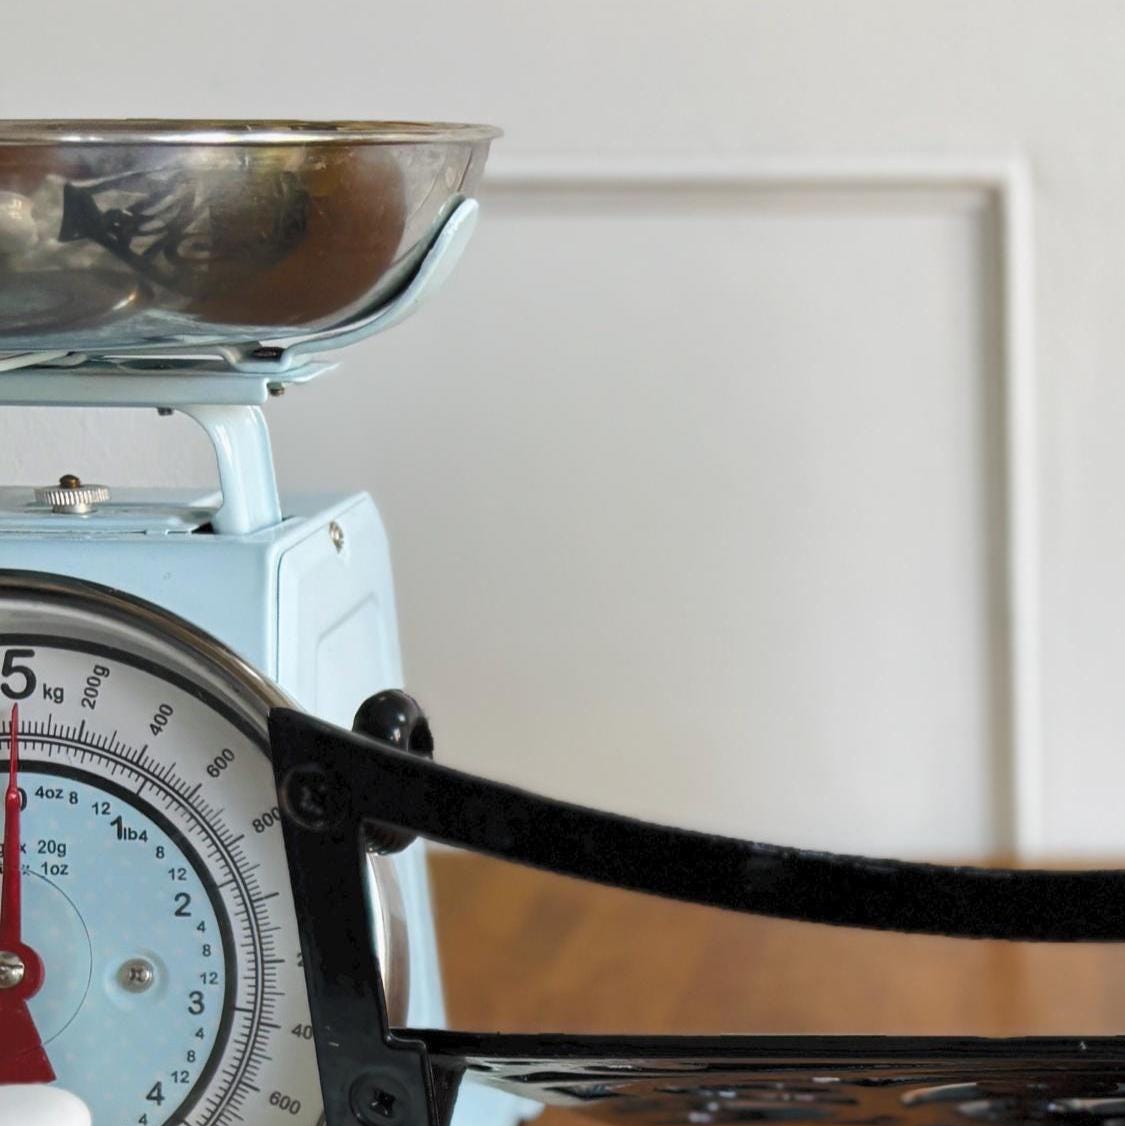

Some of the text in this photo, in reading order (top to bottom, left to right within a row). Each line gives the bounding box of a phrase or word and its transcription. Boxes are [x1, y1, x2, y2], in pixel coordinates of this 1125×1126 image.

[43, 683, 64, 704] kg
[81, 664, 111, 710] 200g
[149, 704, 174, 736] 400
[206, 748, 235, 778] 600
[34, 786, 64, 799] 4oz
[69, 791, 78, 805] 8
[92, 802, 111, 815] 12
[37, 840, 67, 857] 20g
[155, 846, 165, 859] 8
[41, 862, 69, 876] 1oz
[168, 868, 187, 881] 12
[174, 892, 192, 917] 2
[196, 920, 206, 932] 4
[202, 944, 211, 957] 8
[200, 971, 218, 985] 12
[187, 991, 205, 1015] 3
[195, 1027, 205, 1040] 4
[291, 1023, 313, 1040] 40
[186, 1050, 196, 1063] 8
[171, 1070, 190, 1083] 12
[145, 1081, 165, 1106] 4
[268, 1090, 301, 1116] 600
[138, 1113, 148, 1126] 4
